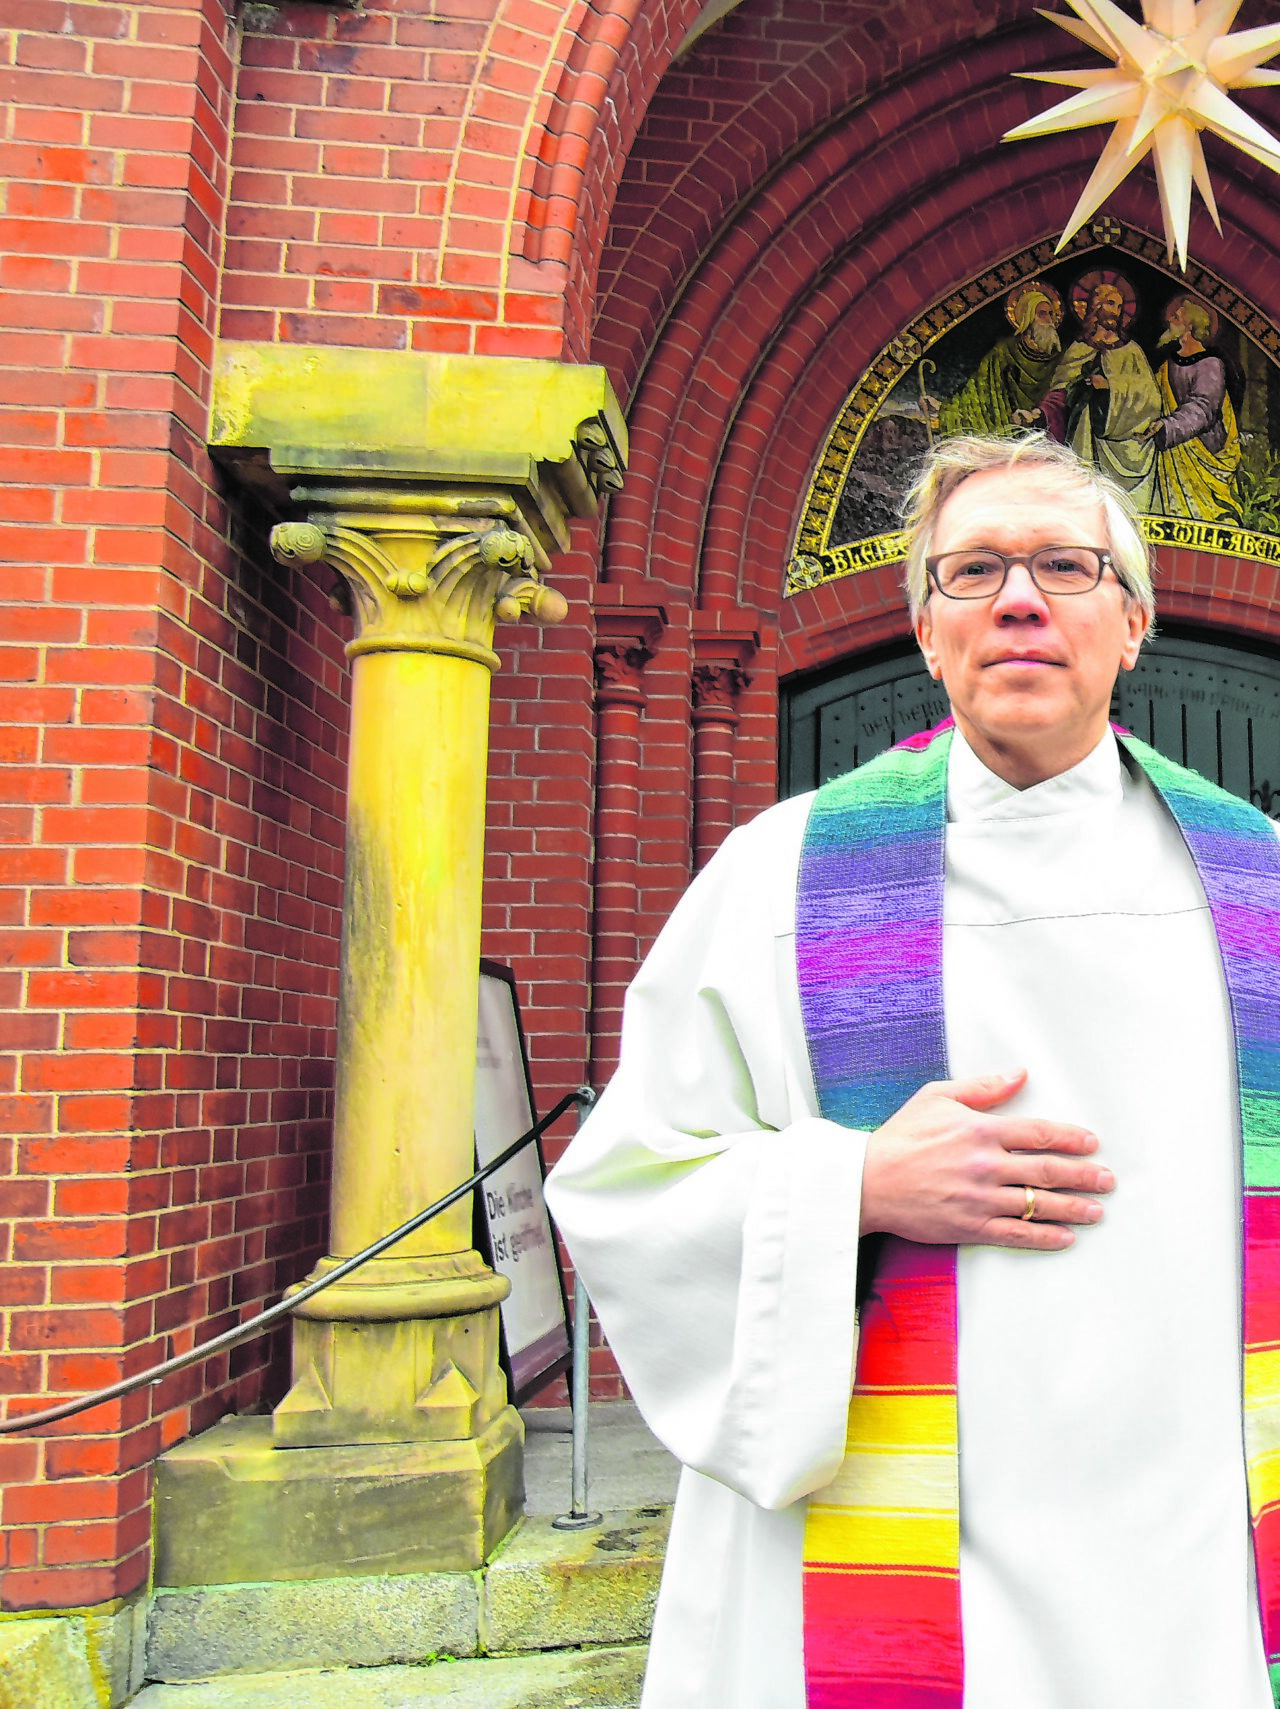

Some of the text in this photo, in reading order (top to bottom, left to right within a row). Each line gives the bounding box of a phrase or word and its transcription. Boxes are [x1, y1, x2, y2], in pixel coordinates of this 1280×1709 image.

[1173, 523, 1224, 549] WILL
[486, 1190, 506, 1221] Die
[492, 1232, 510, 1263] ist
